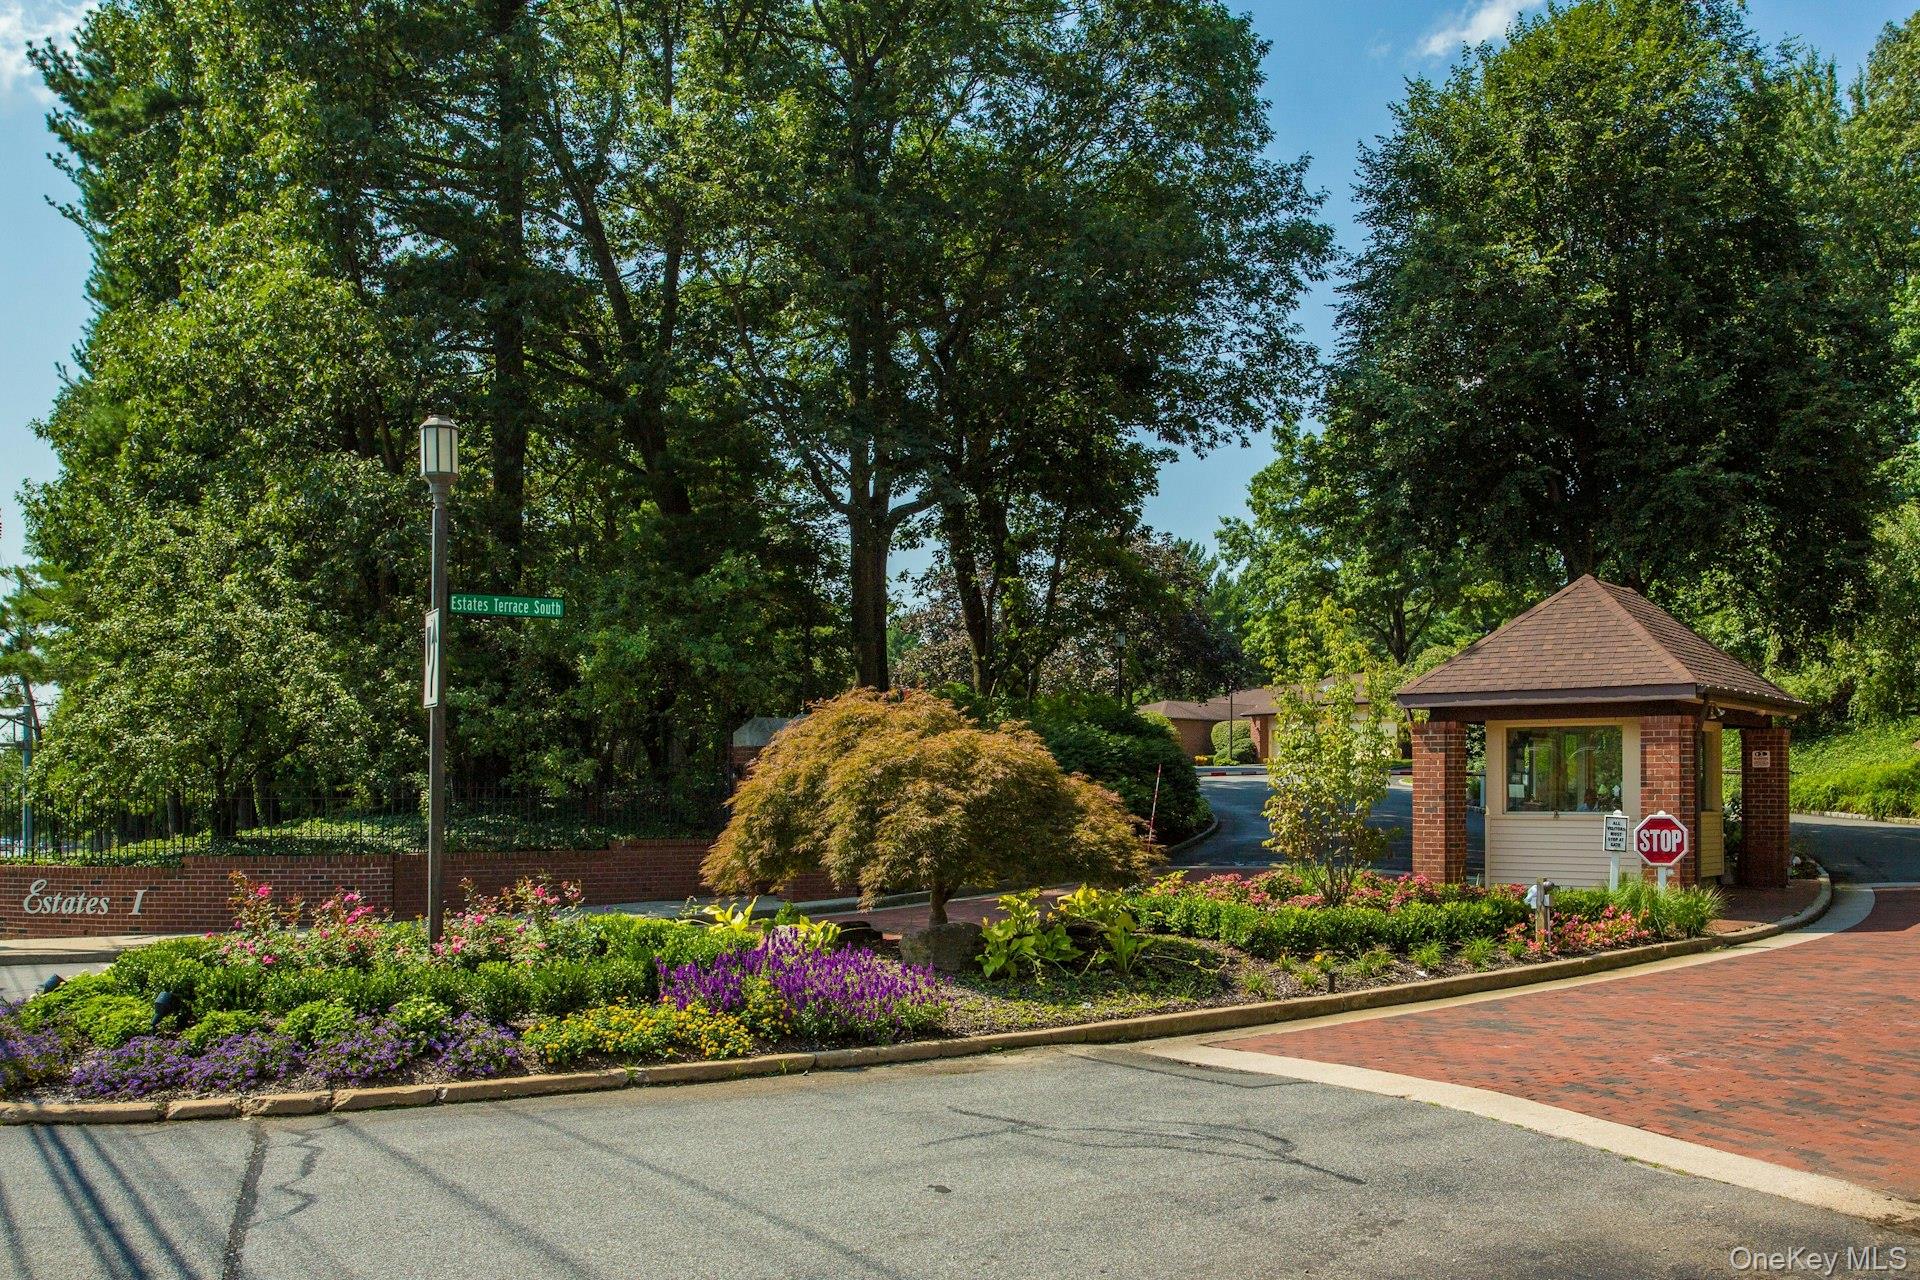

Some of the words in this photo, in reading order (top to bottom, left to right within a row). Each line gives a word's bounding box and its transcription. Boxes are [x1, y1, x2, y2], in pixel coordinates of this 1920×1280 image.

[451, 596, 489, 612] Estates
[493, 598, 529, 614] Terrace
[534, 600, 561, 615] South
[1640, 829, 1682, 852] STOP
[23, 879, 110, 915] Estates
[128, 889, 148, 916] I
